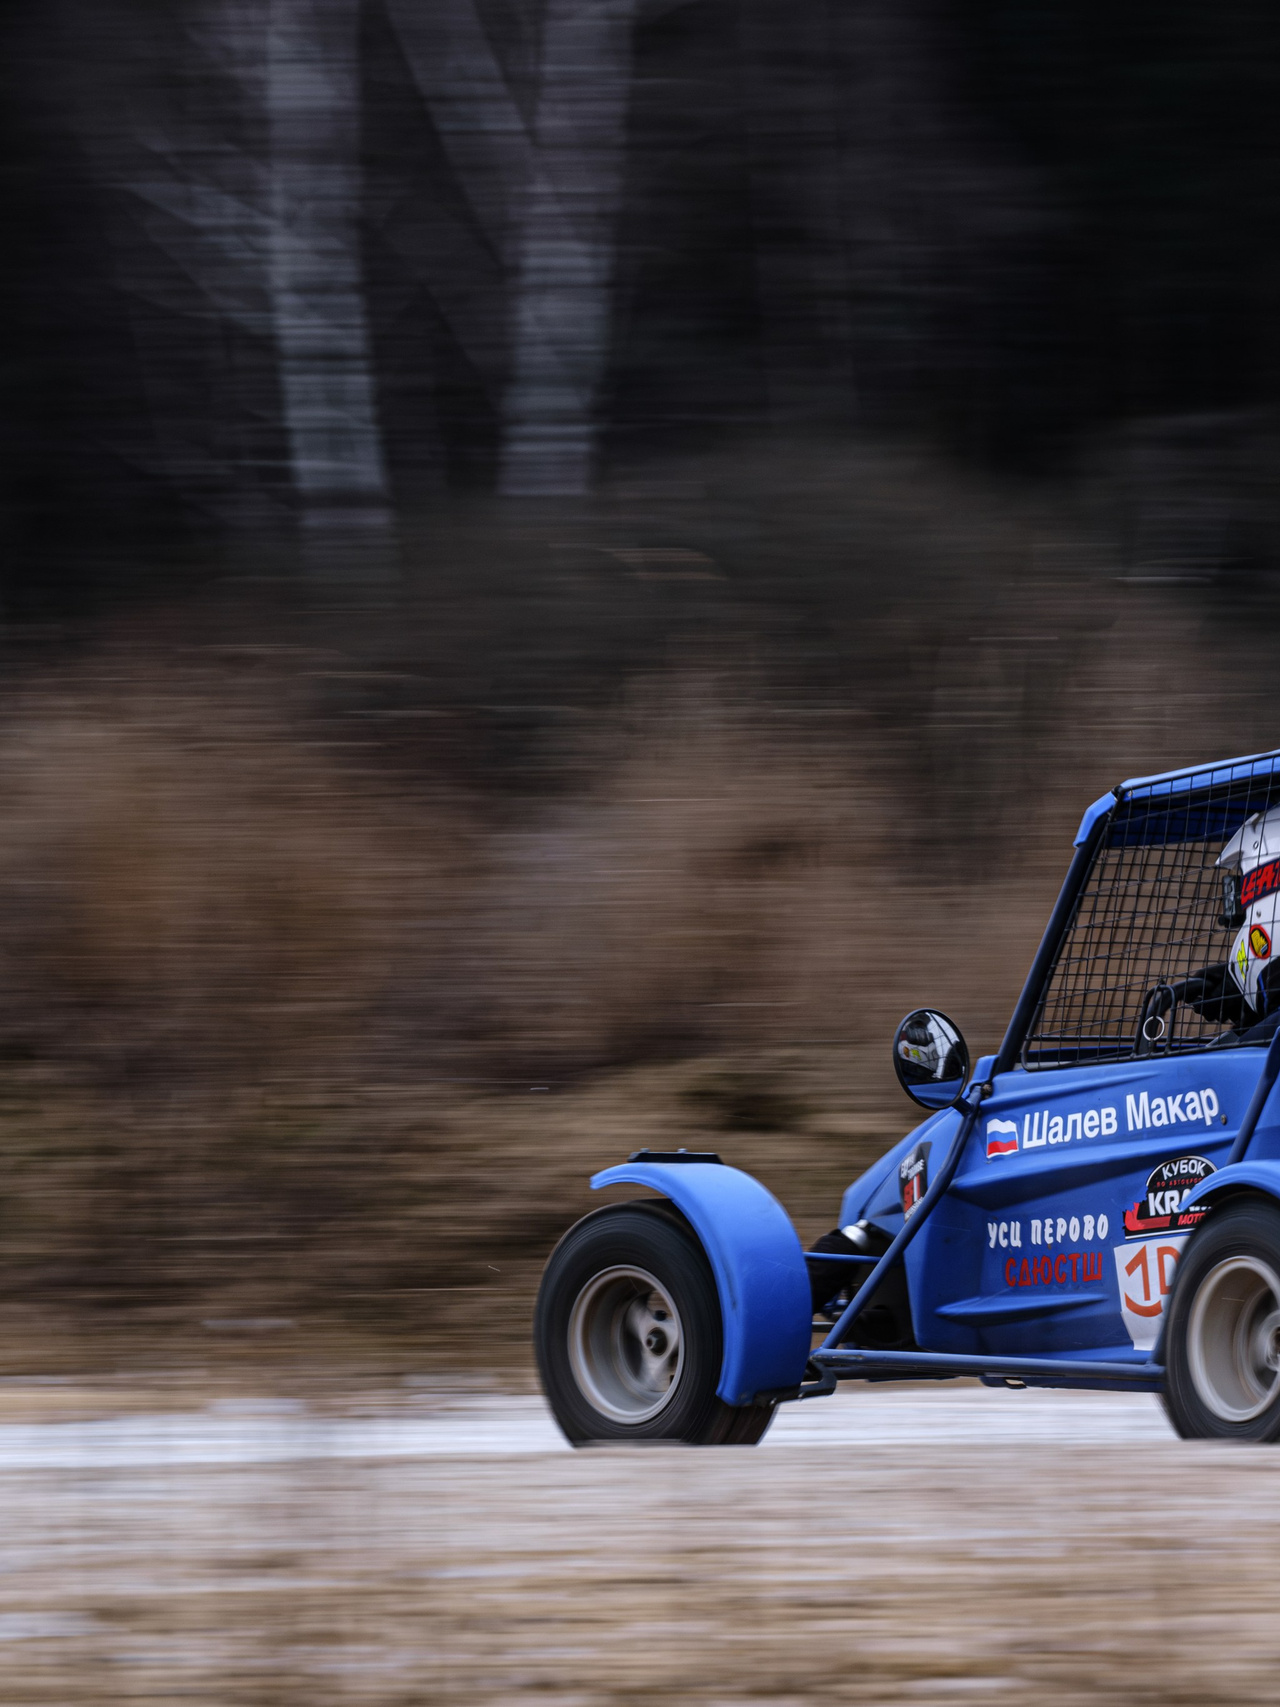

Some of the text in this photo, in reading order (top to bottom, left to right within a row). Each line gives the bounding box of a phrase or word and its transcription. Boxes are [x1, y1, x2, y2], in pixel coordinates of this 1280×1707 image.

[1022, 1087, 1219, 1149] Шалев Макар
[1162, 1159, 1207, 1181] КУБОК
[987, 1213, 1109, 1249] УСЦ ПЕРОВО
[1005, 1252, 1103, 1287] СДЮСТШ
